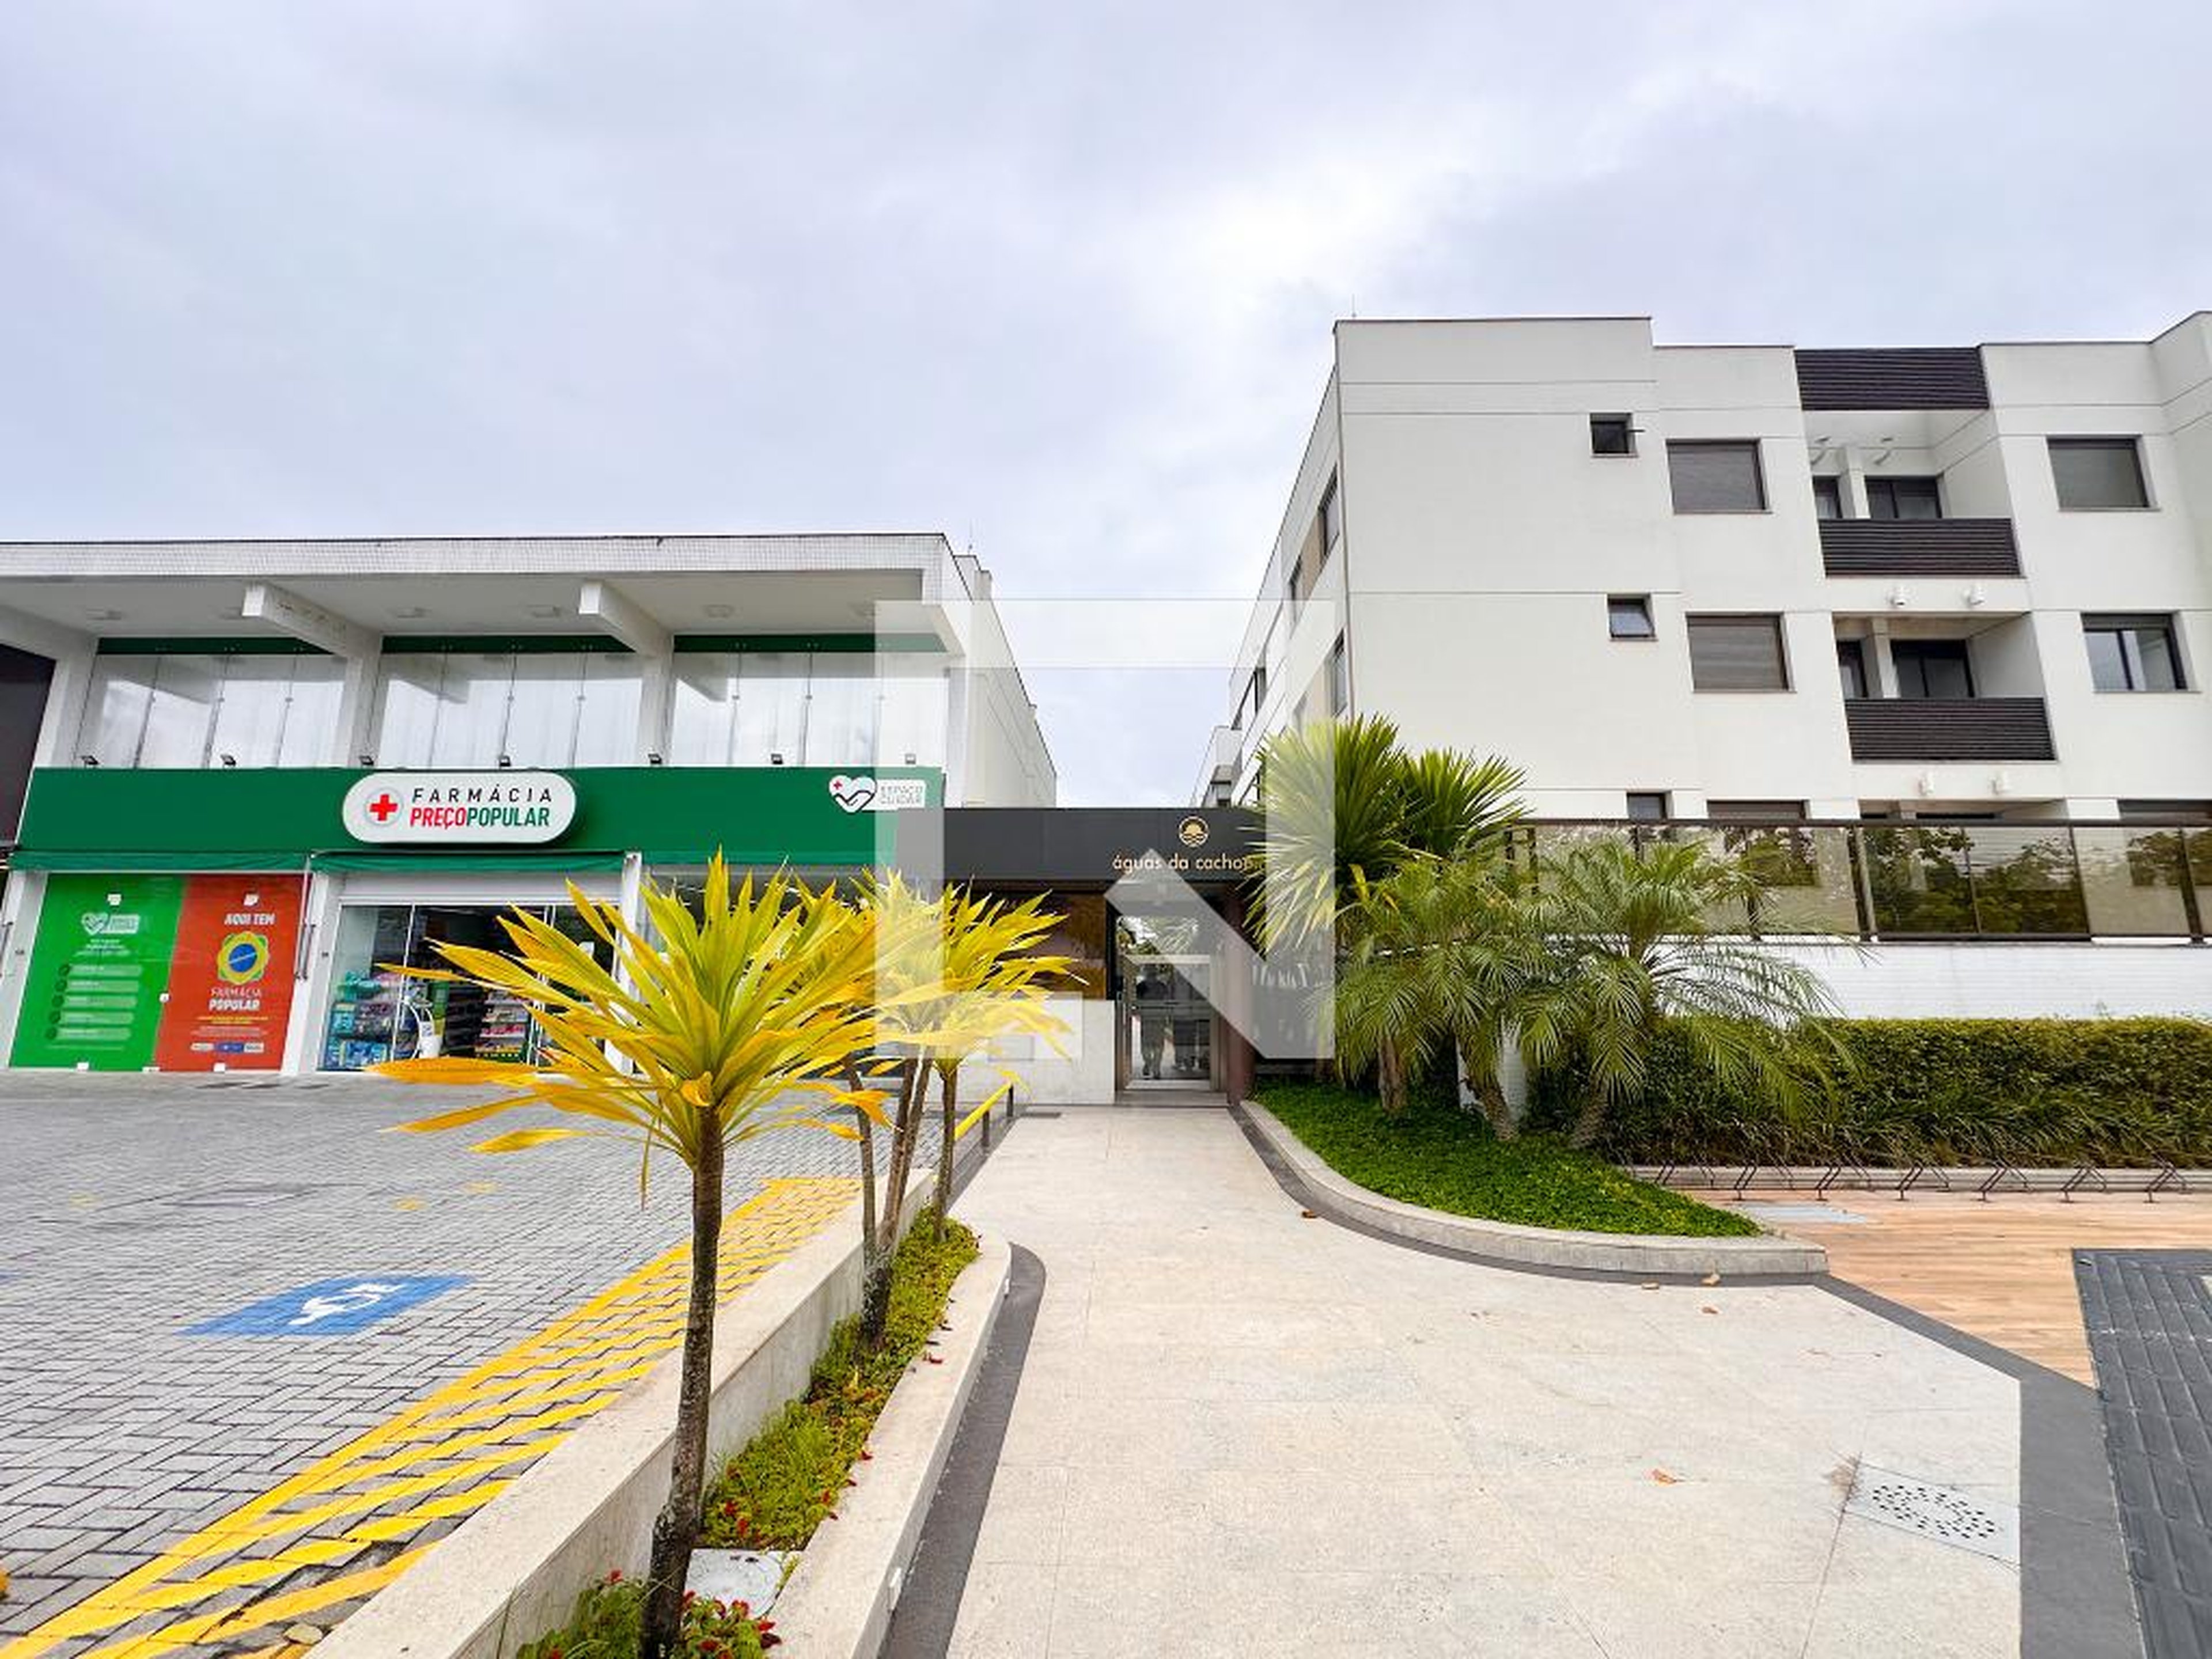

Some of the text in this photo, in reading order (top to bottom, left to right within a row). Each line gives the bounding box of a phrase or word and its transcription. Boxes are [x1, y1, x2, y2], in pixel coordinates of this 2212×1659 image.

[412, 784, 551, 802] FARMÁCIA
[1112, 853, 1265, 874] águas da cachop
[224, 912, 275, 925] AQUI TEM
[209, 999, 260, 1011] POPULAR
